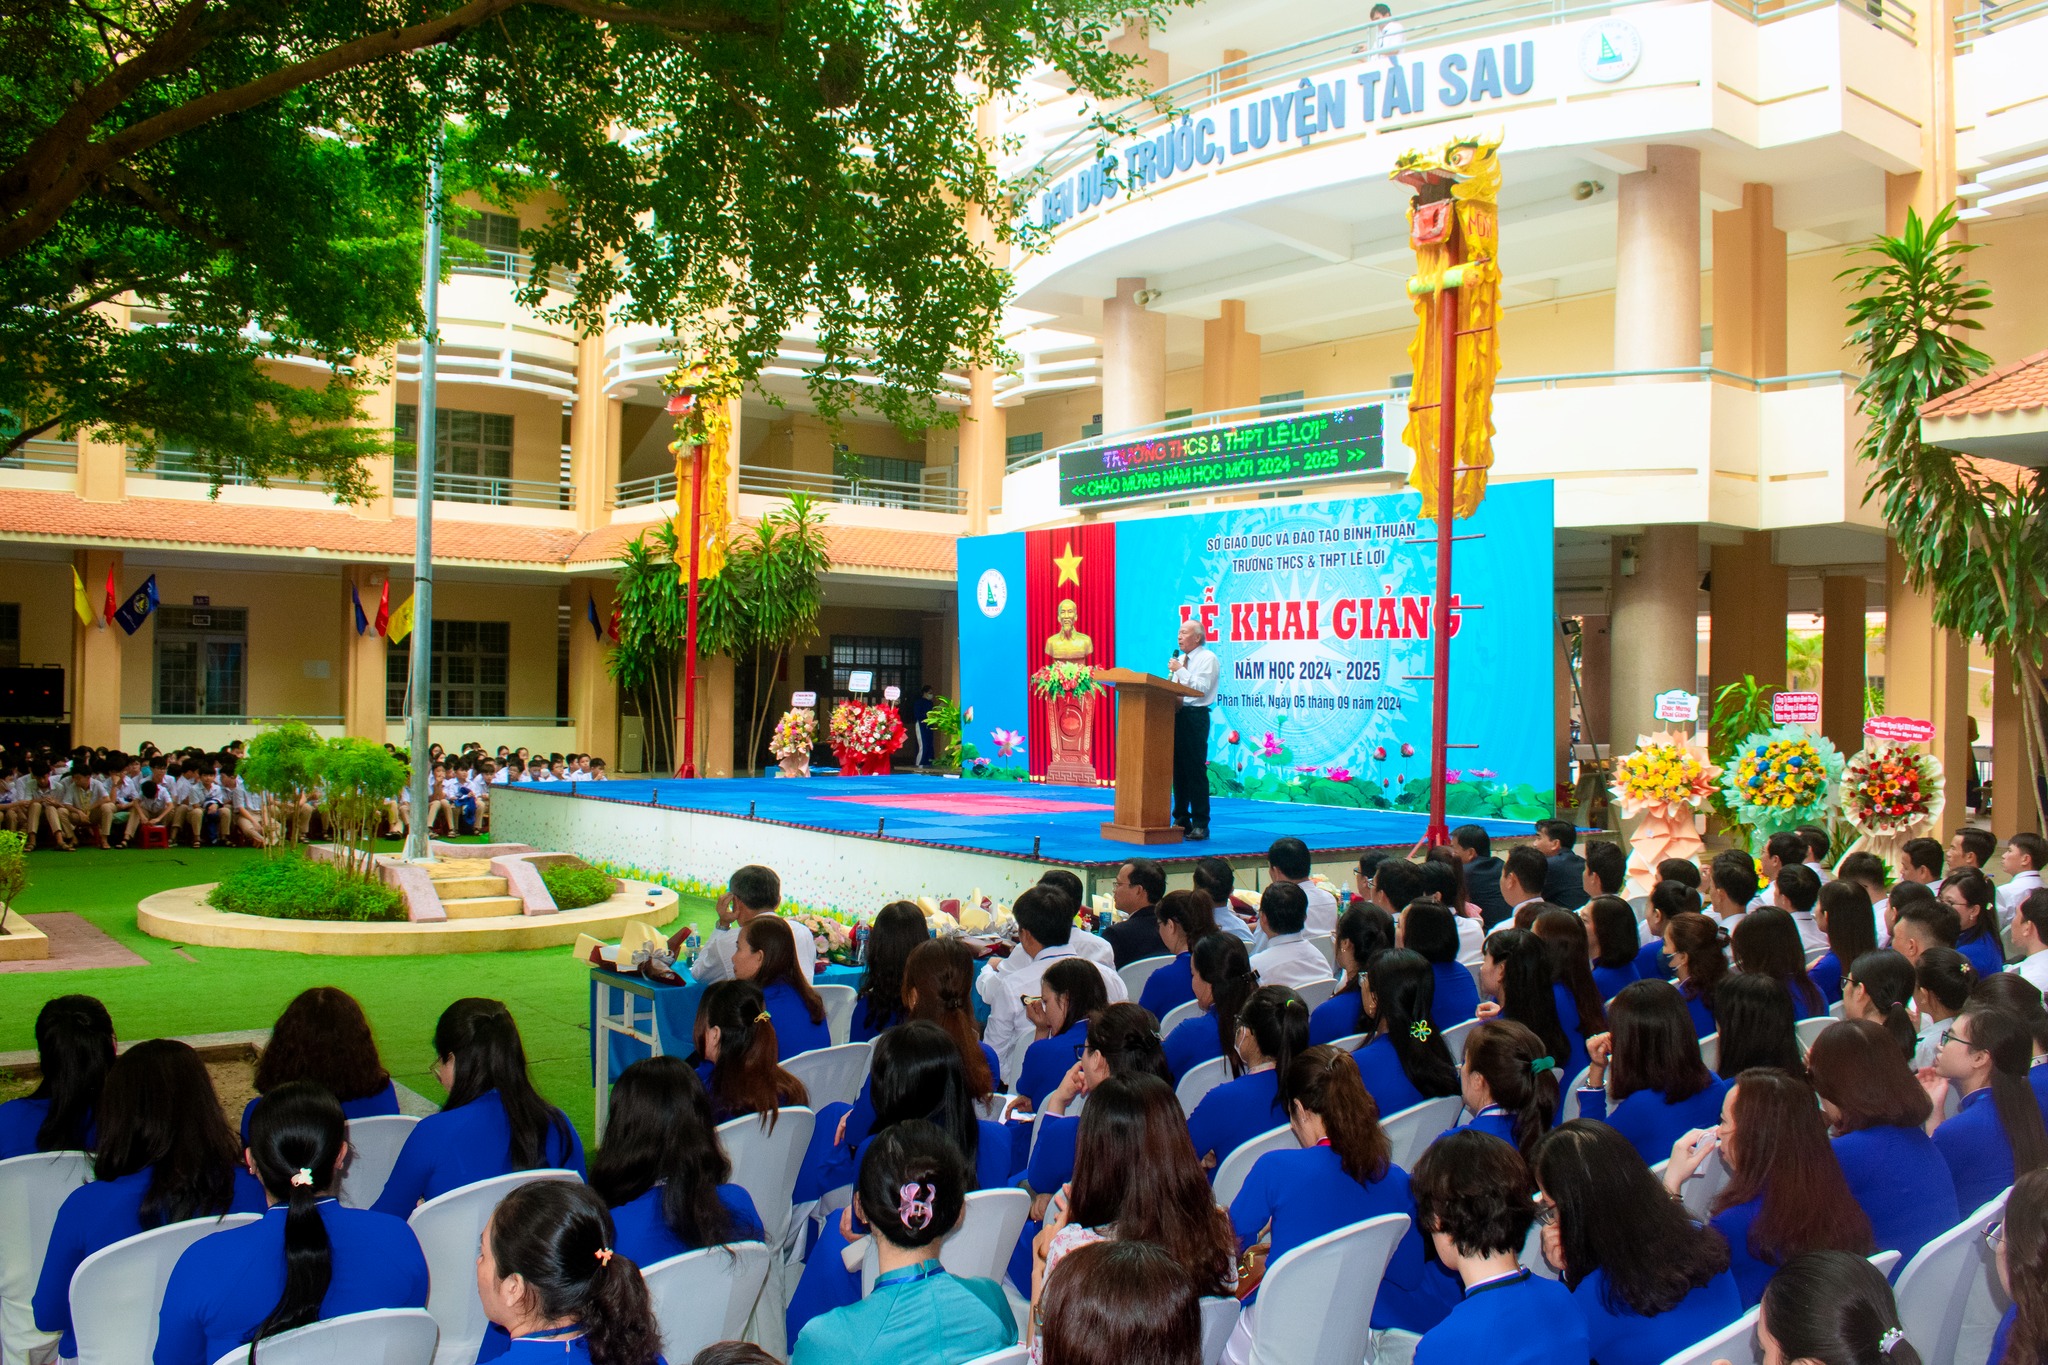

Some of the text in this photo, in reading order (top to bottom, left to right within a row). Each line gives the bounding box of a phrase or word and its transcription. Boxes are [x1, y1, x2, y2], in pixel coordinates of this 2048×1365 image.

[1230, 77, 1346, 155] LUYỆN
[1358, 55, 1424, 122] TÀI
[1438, 40, 1534, 107] SAU
[1168, 435, 1209, 458] THCS
[1210, 434, 1220, 453] &
[1223, 427, 1265, 451] THPT
[1267, 422, 1290, 447] LÊ
[1162, 465, 1191, 487] NĂM
[1193, 463, 1223, 483] HỌC
[1256, 454, 1291, 476] 2024
[1303, 448, 1340, 471] 2025
[1207, 520, 1415, 551] SỞ GIÁO DỤC VÀ ĐÀO TẠO BÌNH THUẬN
[1232, 548, 1385, 573] TRƯỜNG THCS & THPT LÊ LỢI
[1231, 600, 1319, 641] KHAI
[1235, 657, 1264, 680] NĂM
[1269, 661, 1295, 684] HỌC
[1299, 661, 1332, 680] 2024
[1346, 661, 1380, 680] 2025
[1217, 692, 1402, 710] Phan Thiết, Ngày 05 tháng 09 năm 2024
